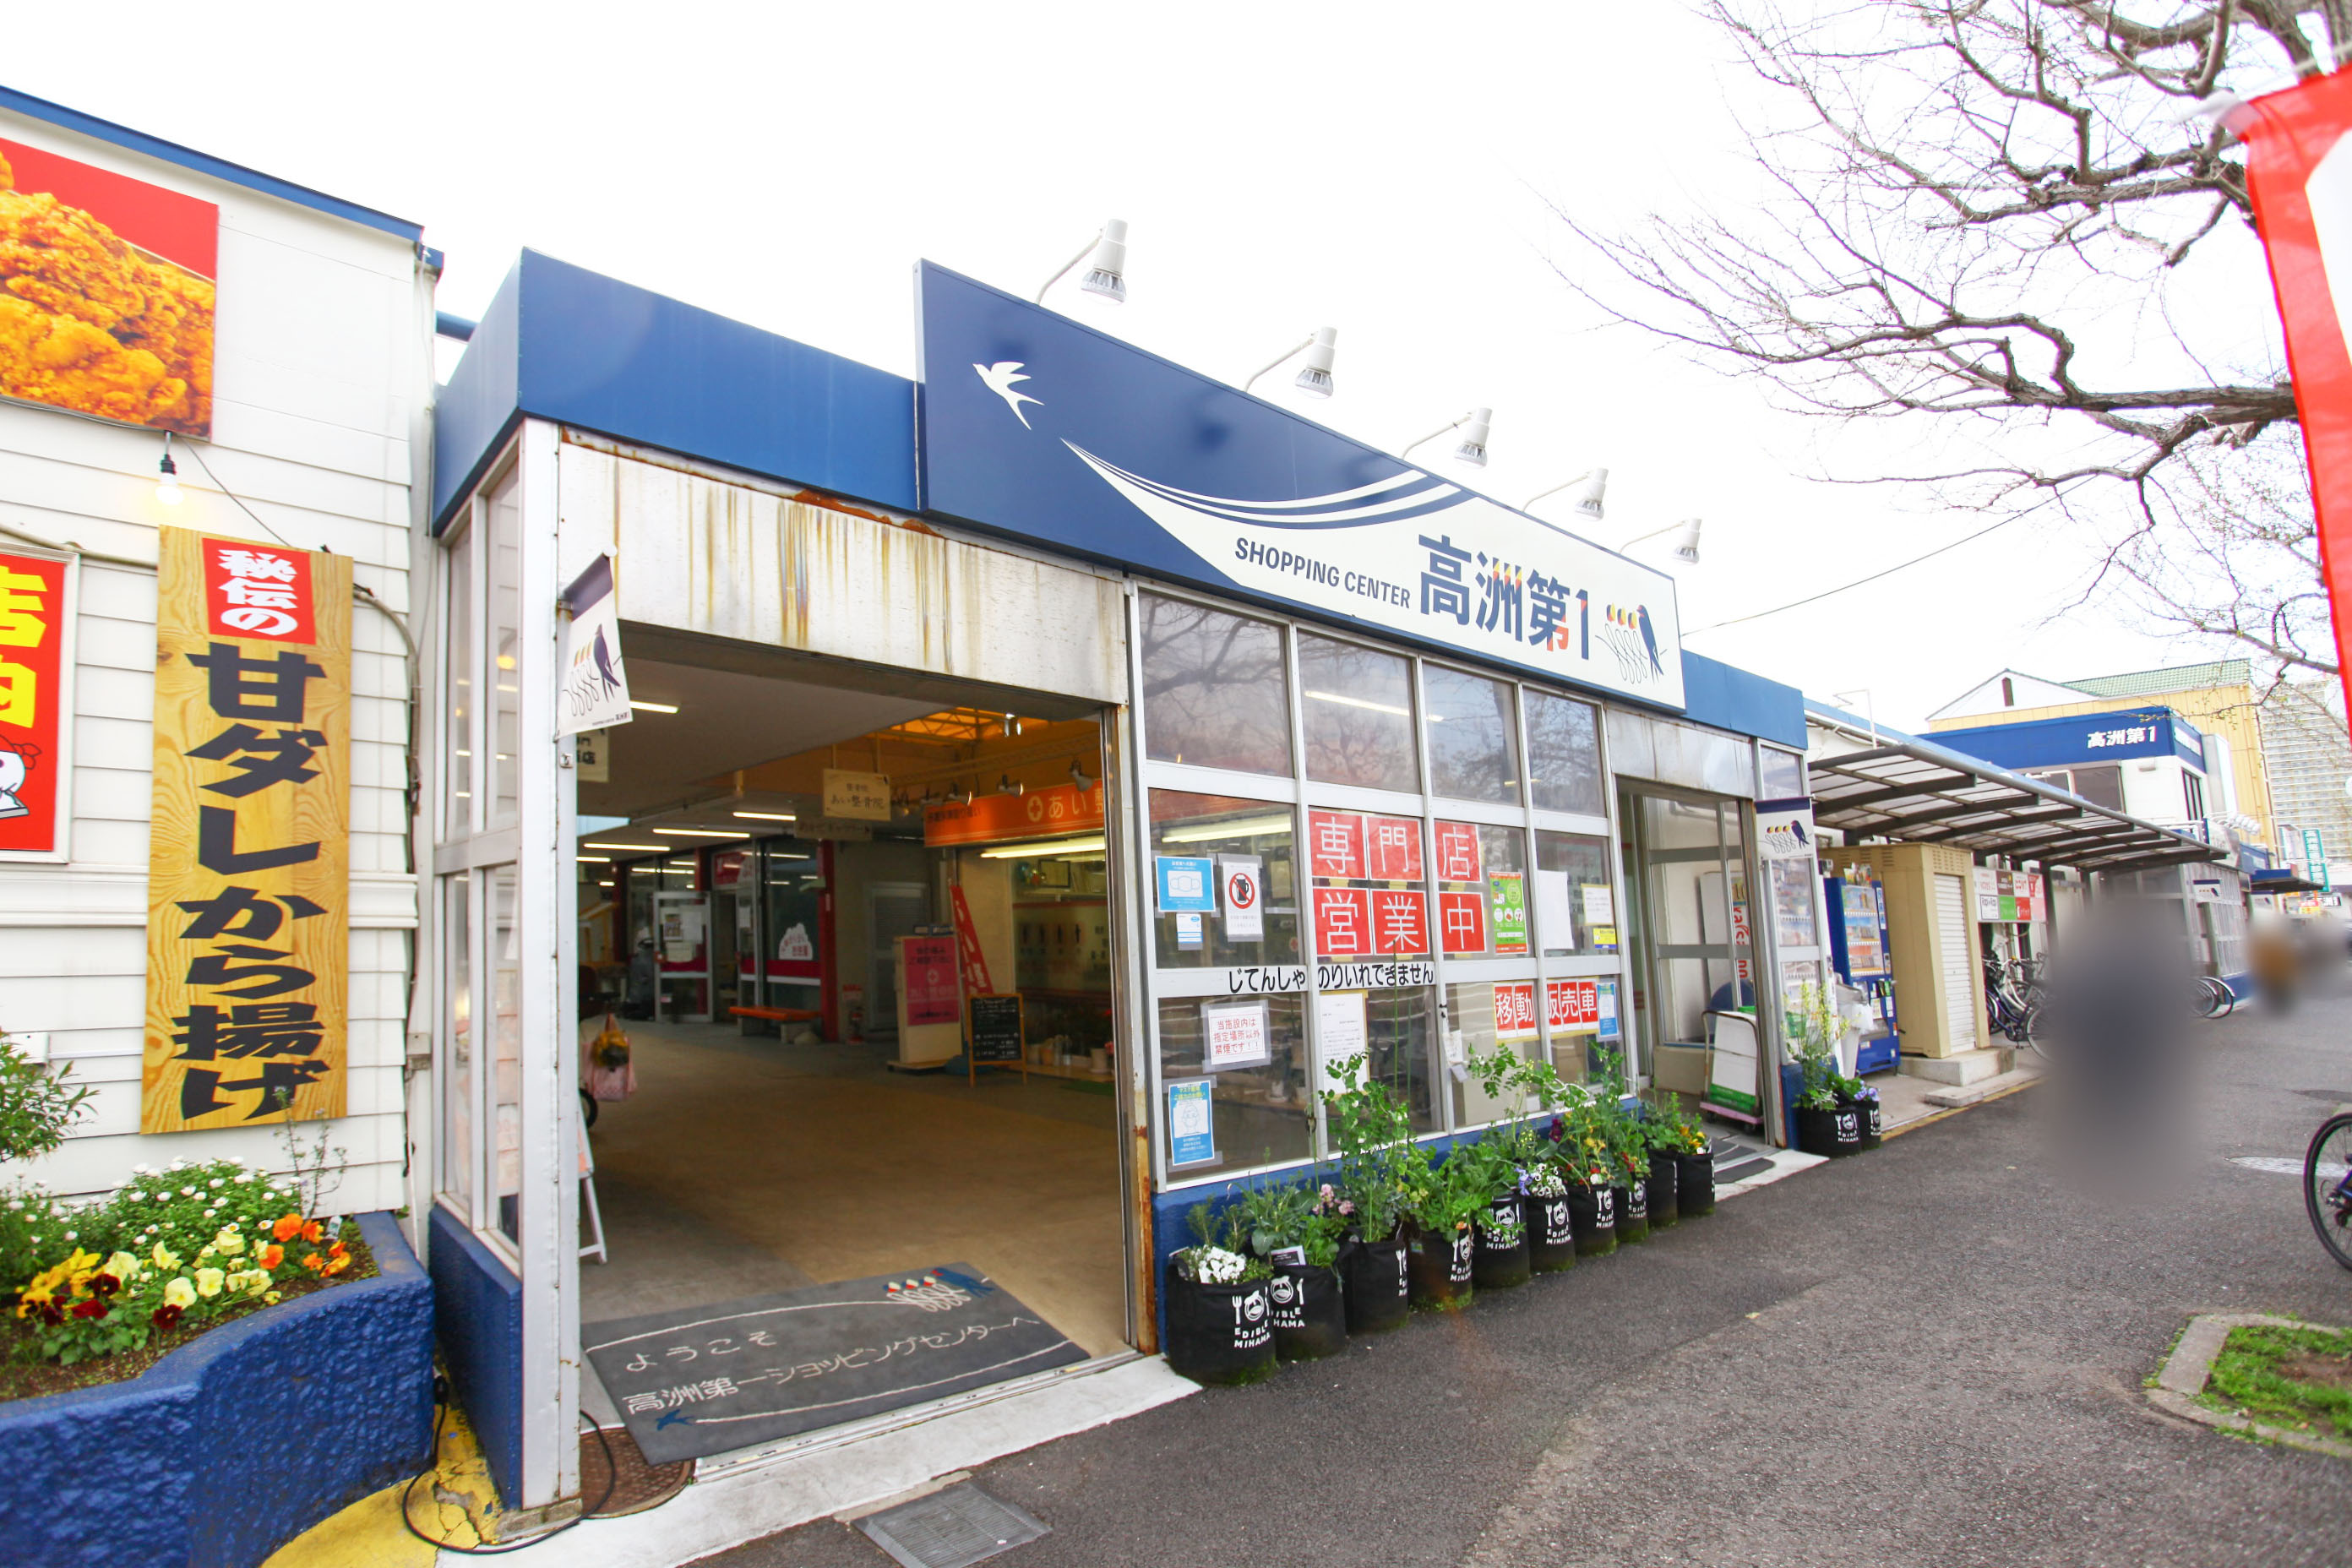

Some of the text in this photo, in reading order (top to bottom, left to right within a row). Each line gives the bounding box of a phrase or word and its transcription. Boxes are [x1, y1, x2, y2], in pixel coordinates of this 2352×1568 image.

[1235, 536, 1411, 609] SHOPPING CENTER
[217, 549, 298, 636] 秘伝の
[1418, 533, 1589, 661] 高洲第1
[2087, 725, 2157, 749] 高洲第1
[1315, 815, 1475, 881] 専門店
[171, 642, 329, 1121] 甘ダレから揚げ
[1320, 892, 1476, 953] 営業中
[1217, 1017, 1257, 1031] 当施設内は
[1495, 992, 1533, 1025] 移動
[1213, 1029, 1260, 1043] 指定場所以外
[1546, 1233, 1571, 1244] MIHAMA
[1234, 1319, 1269, 1339] EDIBLE
[1271, 1307, 1301, 1319] IBLE
[1273, 1319, 1305, 1328] HAMA
[625, 1331, 778, 1373] ようこそ
[1233, 1331, 1271, 1348] MIHAMA
[622, 1316, 1040, 1414] 高洲第一ショッピングセンターへ
